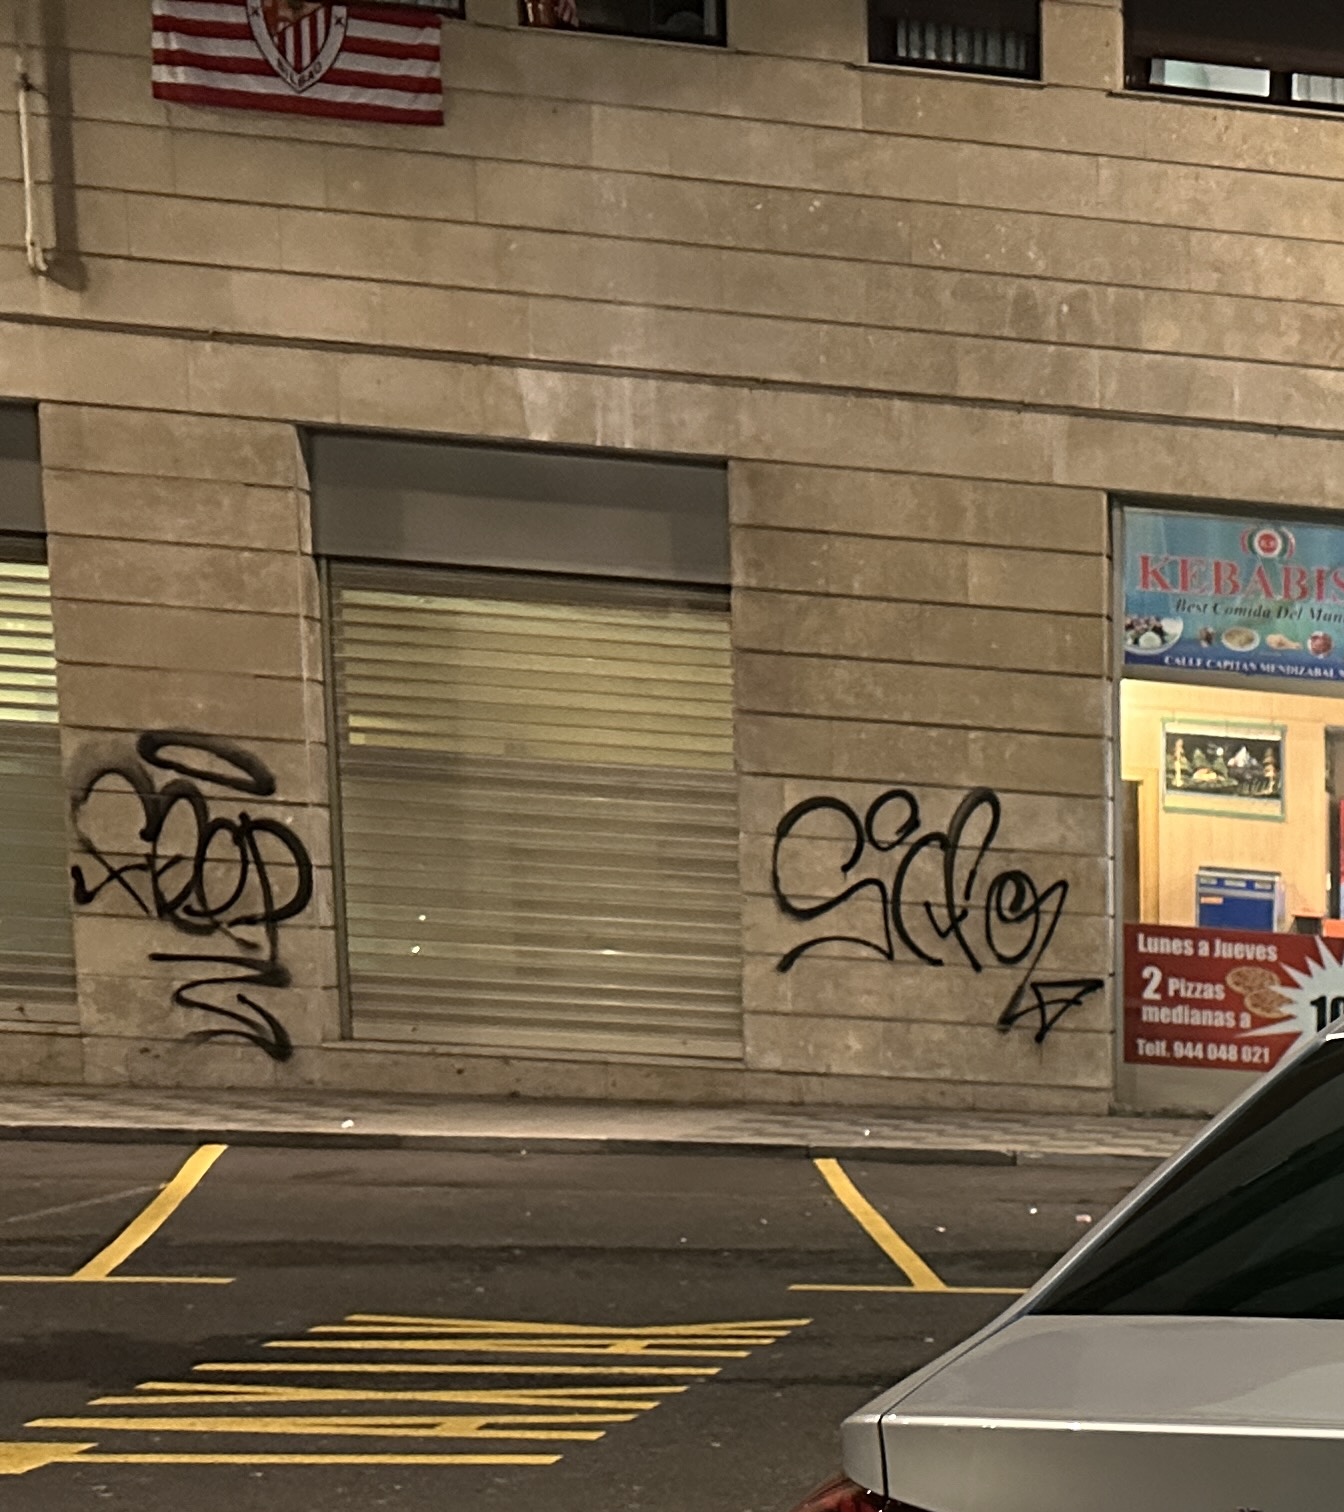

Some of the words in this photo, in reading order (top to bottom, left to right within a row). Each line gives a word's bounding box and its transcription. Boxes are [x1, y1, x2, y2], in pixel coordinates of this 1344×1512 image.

[1175, 598, 1208, 613] Best
[1212, 602, 1271, 620] Comida
[1276, 606, 1303, 621] Del
[1164, 655, 1202, 669] CALLE
[1206, 658, 1257, 673] CAPITAN
[1137, 932, 1193, 956] Lunes
[1198, 941, 1210, 956] a
[1213, 938, 1278, 962] Jueves
[1142, 966, 1163, 1000] 2
[1168, 977, 1226, 1000] Pizzas
[1141, 1005, 1236, 1028] medianas
[1240, 1012, 1251, 1029] a
[1173, 1041, 1203, 1059] 944
